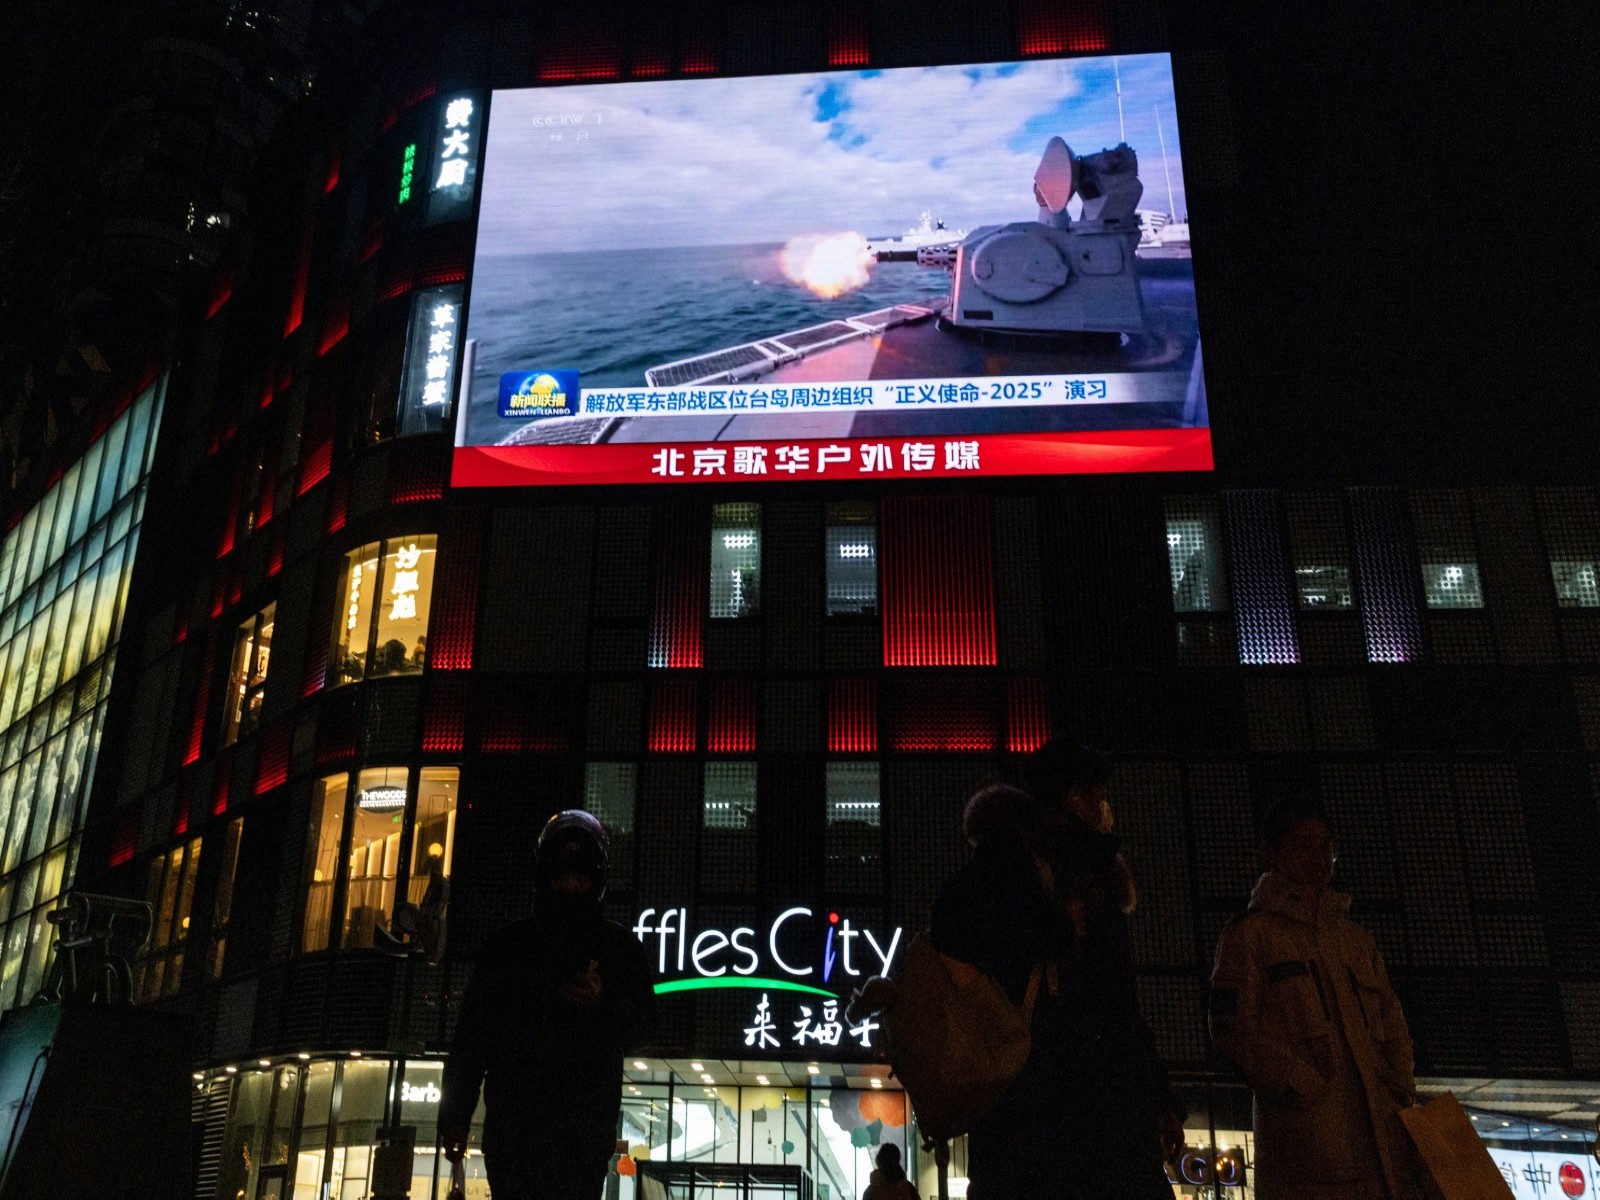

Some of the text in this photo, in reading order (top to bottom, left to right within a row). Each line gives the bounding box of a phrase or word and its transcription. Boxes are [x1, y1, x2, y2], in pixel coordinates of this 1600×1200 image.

[503, 407, 571, 417] XINWEN LIANBO
[510, 392, 567, 409] 新闻联播
[651, 440, 981, 477] 北京歌华户外传媒
[769, 907, 902, 983] City
